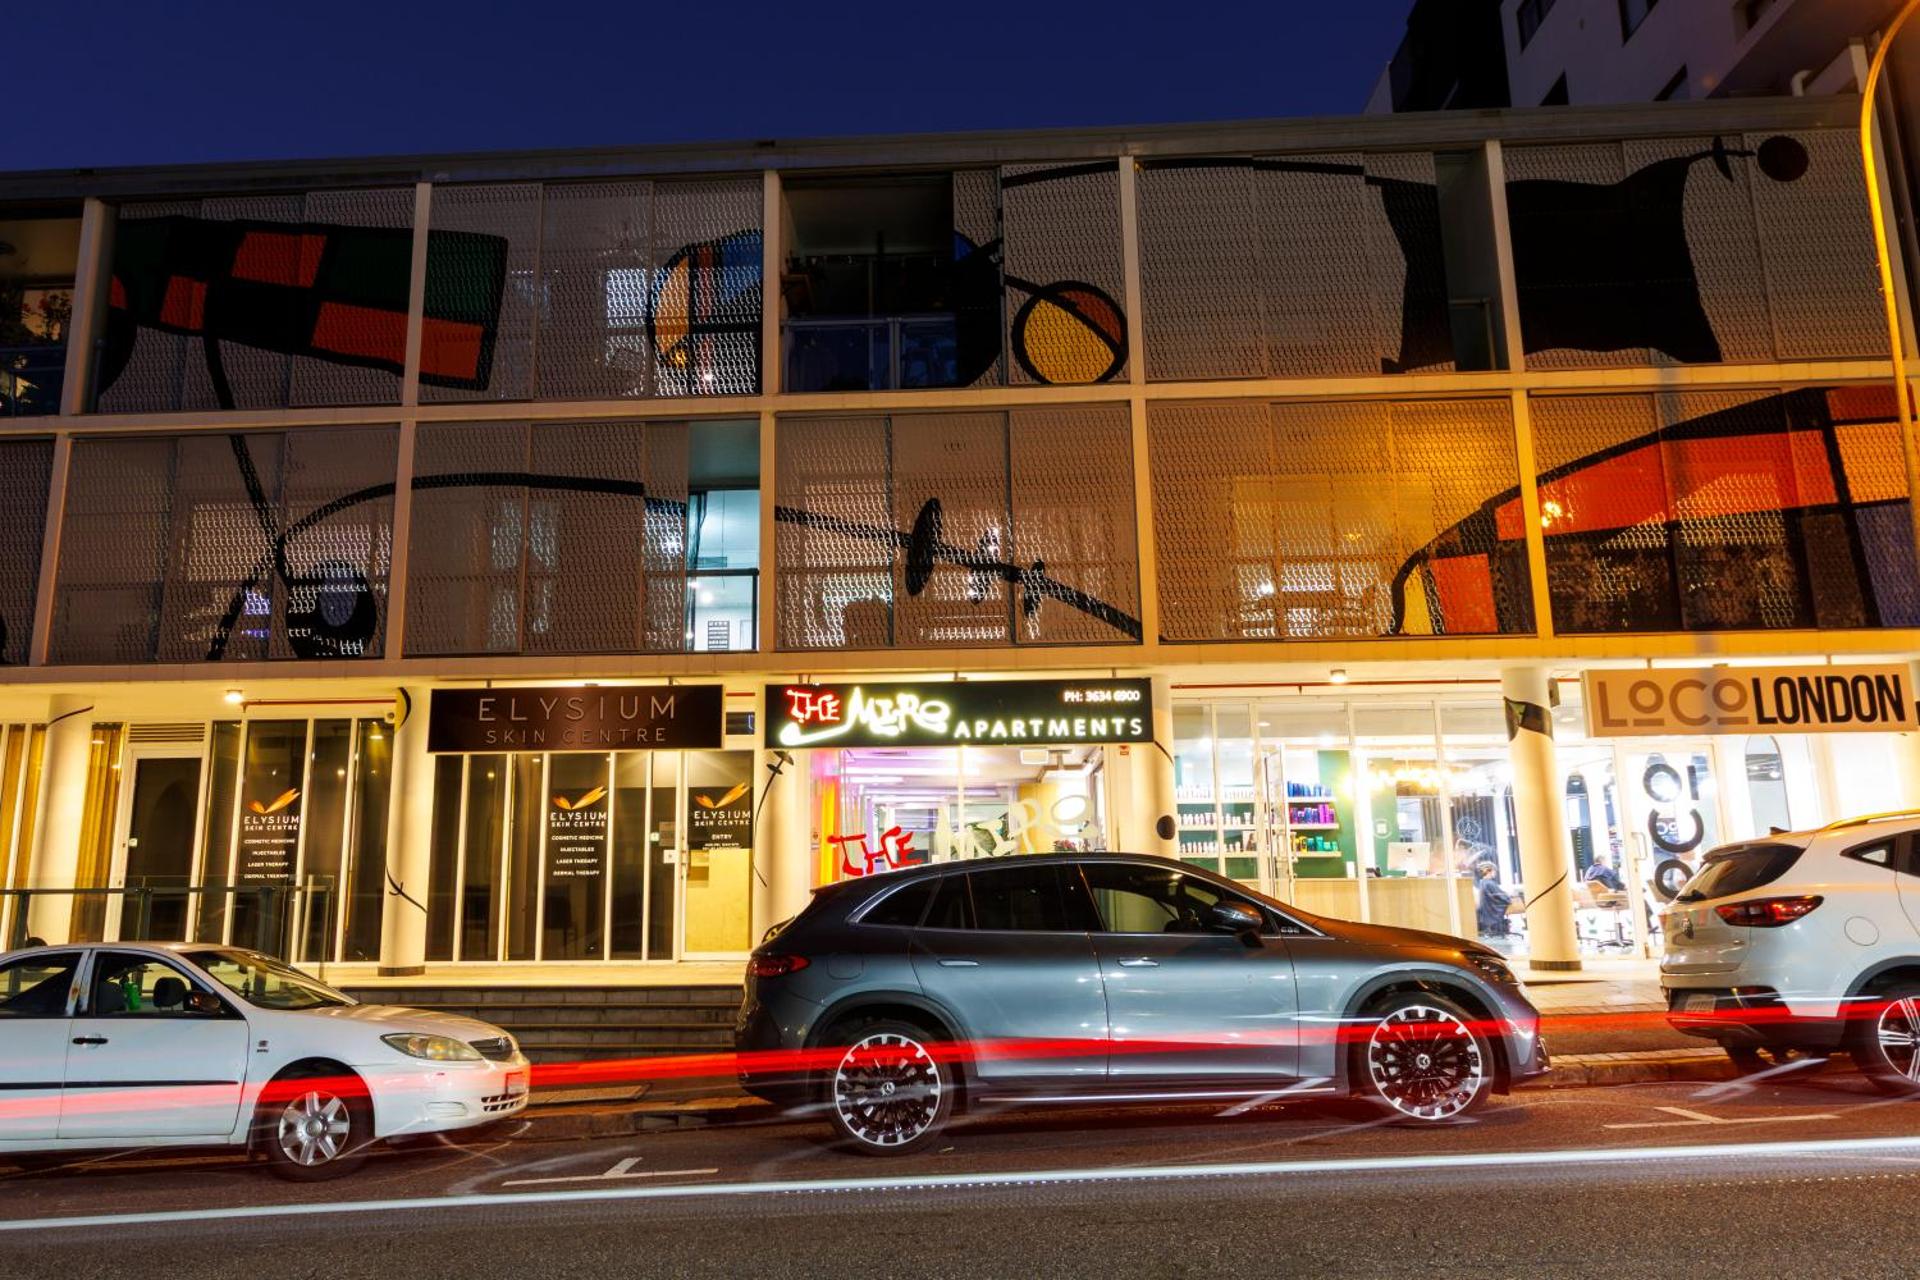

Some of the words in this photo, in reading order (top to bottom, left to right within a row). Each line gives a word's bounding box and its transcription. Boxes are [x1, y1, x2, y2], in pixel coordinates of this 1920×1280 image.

[786, 688, 841, 722] THE
[1063, 690, 1083, 703] PH:
[1085, 690, 1112, 702] 3634
[1752, 673, 1906, 726] LONDON
[479, 695, 675, 721] ELYSIUM
[779, 686, 951, 746] MIRO
[485, 728, 545, 745] SKIN
[562, 727, 667, 745] CENTRE
[954, 718, 1143, 739] APARTMENTS
[244, 816, 299, 824] ELYSIUM
[550, 812, 607, 821] ELYSIUM
[694, 811, 751, 819] ELYSIUM
[827, 825, 922, 876] THE
